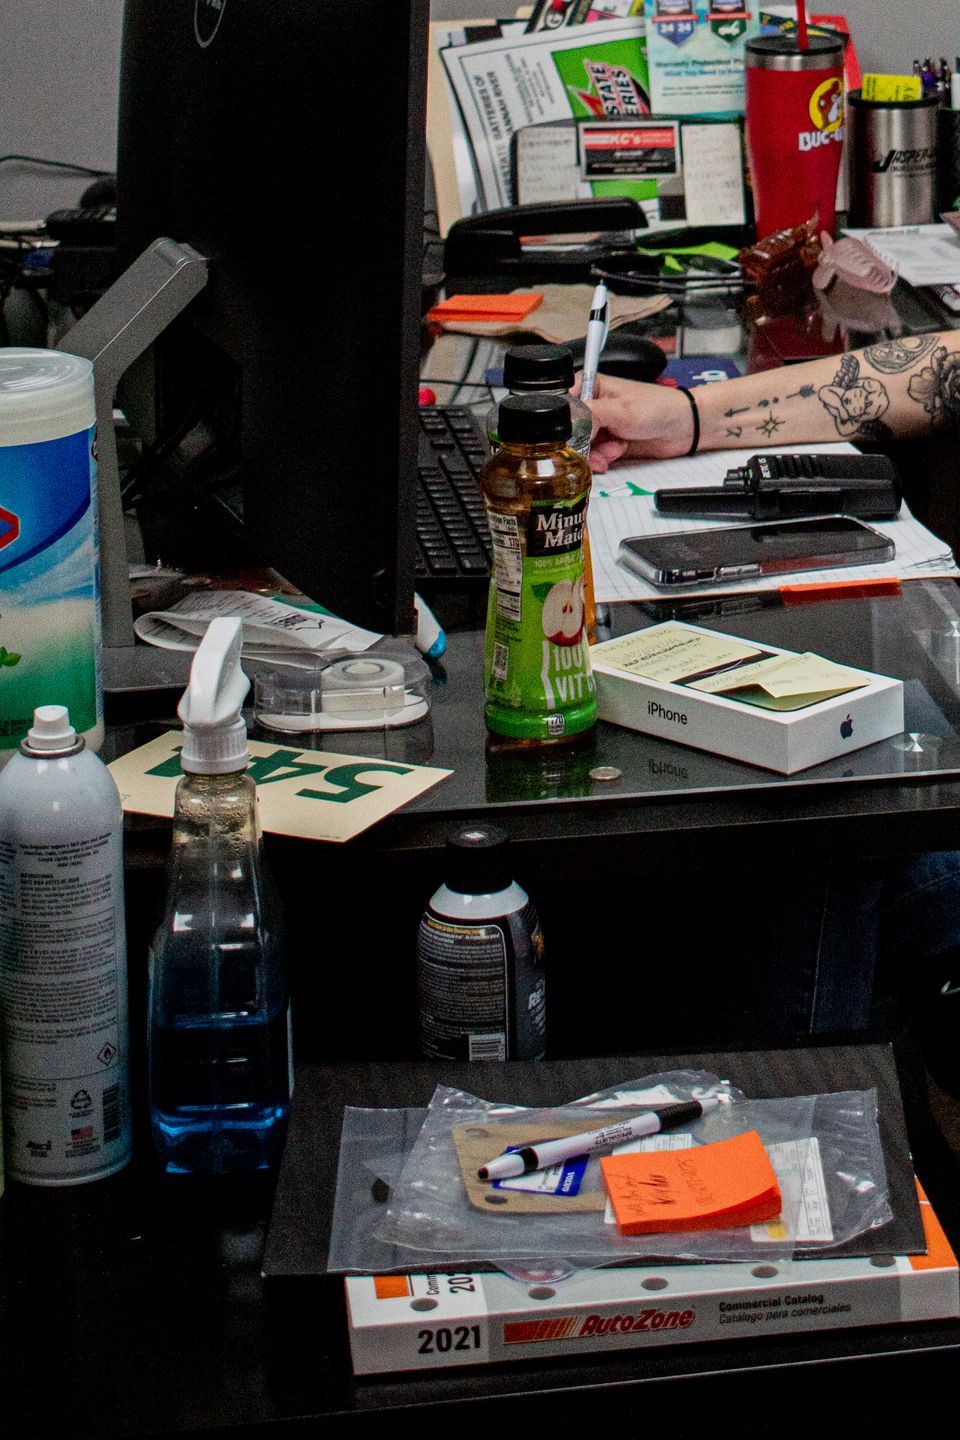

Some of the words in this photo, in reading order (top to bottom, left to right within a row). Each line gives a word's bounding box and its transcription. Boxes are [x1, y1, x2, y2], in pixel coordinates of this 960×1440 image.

[590, 66, 621, 117] STATE
[555, 672, 583, 703] VIT
[647, 701, 688, 725] iPhone
[450, 1273, 475, 1294] 20
[719, 1297, 781, 1312] Commercial
[784, 1293, 824, 1309] Catalog
[765, 1309, 788, 1321] para
[790, 1303, 852, 1318] comerciales
[579, 1309, 694, 1337] AutoZone
[418, 1325, 481, 1354] 2021
